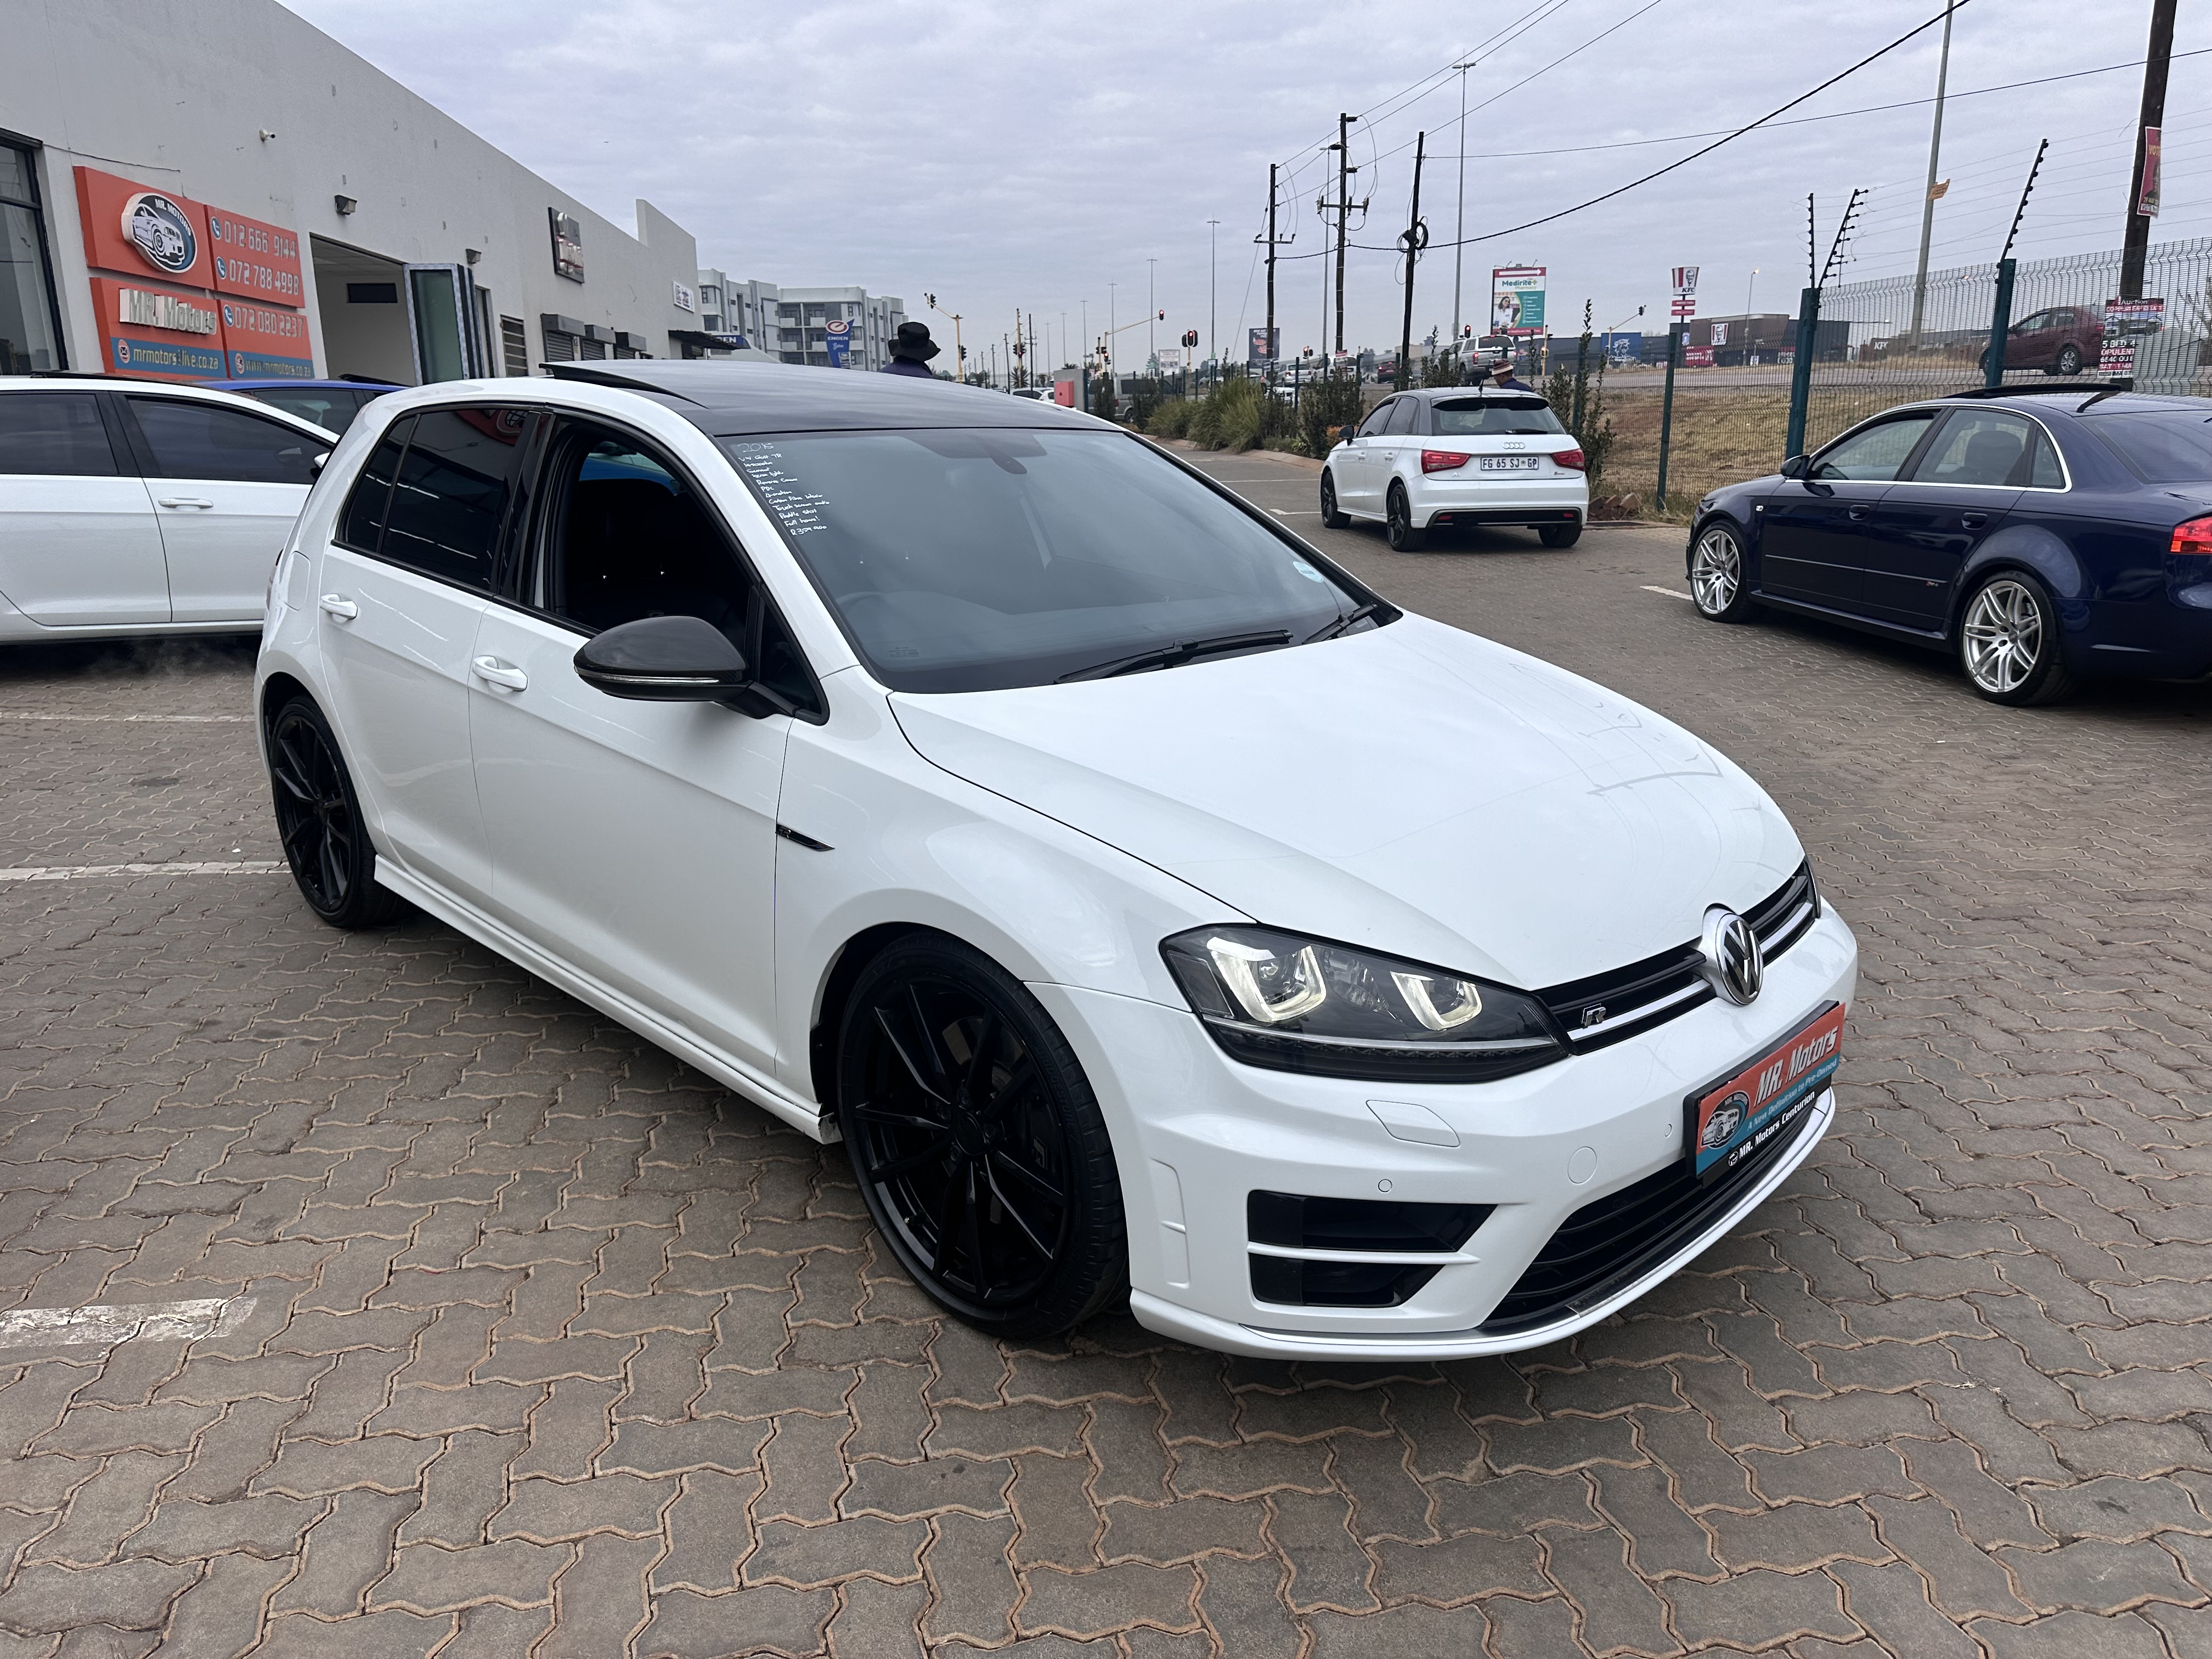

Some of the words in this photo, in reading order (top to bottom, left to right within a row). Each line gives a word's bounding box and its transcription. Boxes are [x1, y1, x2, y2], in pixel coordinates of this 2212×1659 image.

[154, 198, 167, 211] MR.
[167, 202, 191, 236] MOTORS
[224, 220, 246, 247] 012
[249, 228, 268, 253] 666
[274, 235, 297, 261] 9144
[229, 259, 250, 285] 072
[253, 264, 273, 290] 788
[275, 271, 300, 295] 4998
[126, 289, 159, 325] MR.
[162, 295, 217, 335] Motors
[234, 307, 256, 331] 072
[258, 311, 278, 334] 080
[279, 314, 304, 338] 2237
[1483, 459, 1493, 469] FG
[1496, 458, 1506, 468] 65
[1510, 458, 1520, 468] SJ
[1527, 458, 1537, 469] GP
[1582, 1003, 1606, 1029] R
[1754, 1058, 1784, 1107] MR.
[1785, 1025, 1839, 1085] Motors
[1746, 1121, 1753, 1131] A
[1753, 1111, 1767, 1126] New
[1768, 1087, 1797, 1116] Definition
[1798, 1082, 1804, 1092] to
[1805, 1058, 1837, 1086] Pre-Owned
[1739, 1141, 1753, 1159] MR.
[1755, 1120, 1780, 1147] Motors
[1781, 1091, 1815, 1125] Centurion
